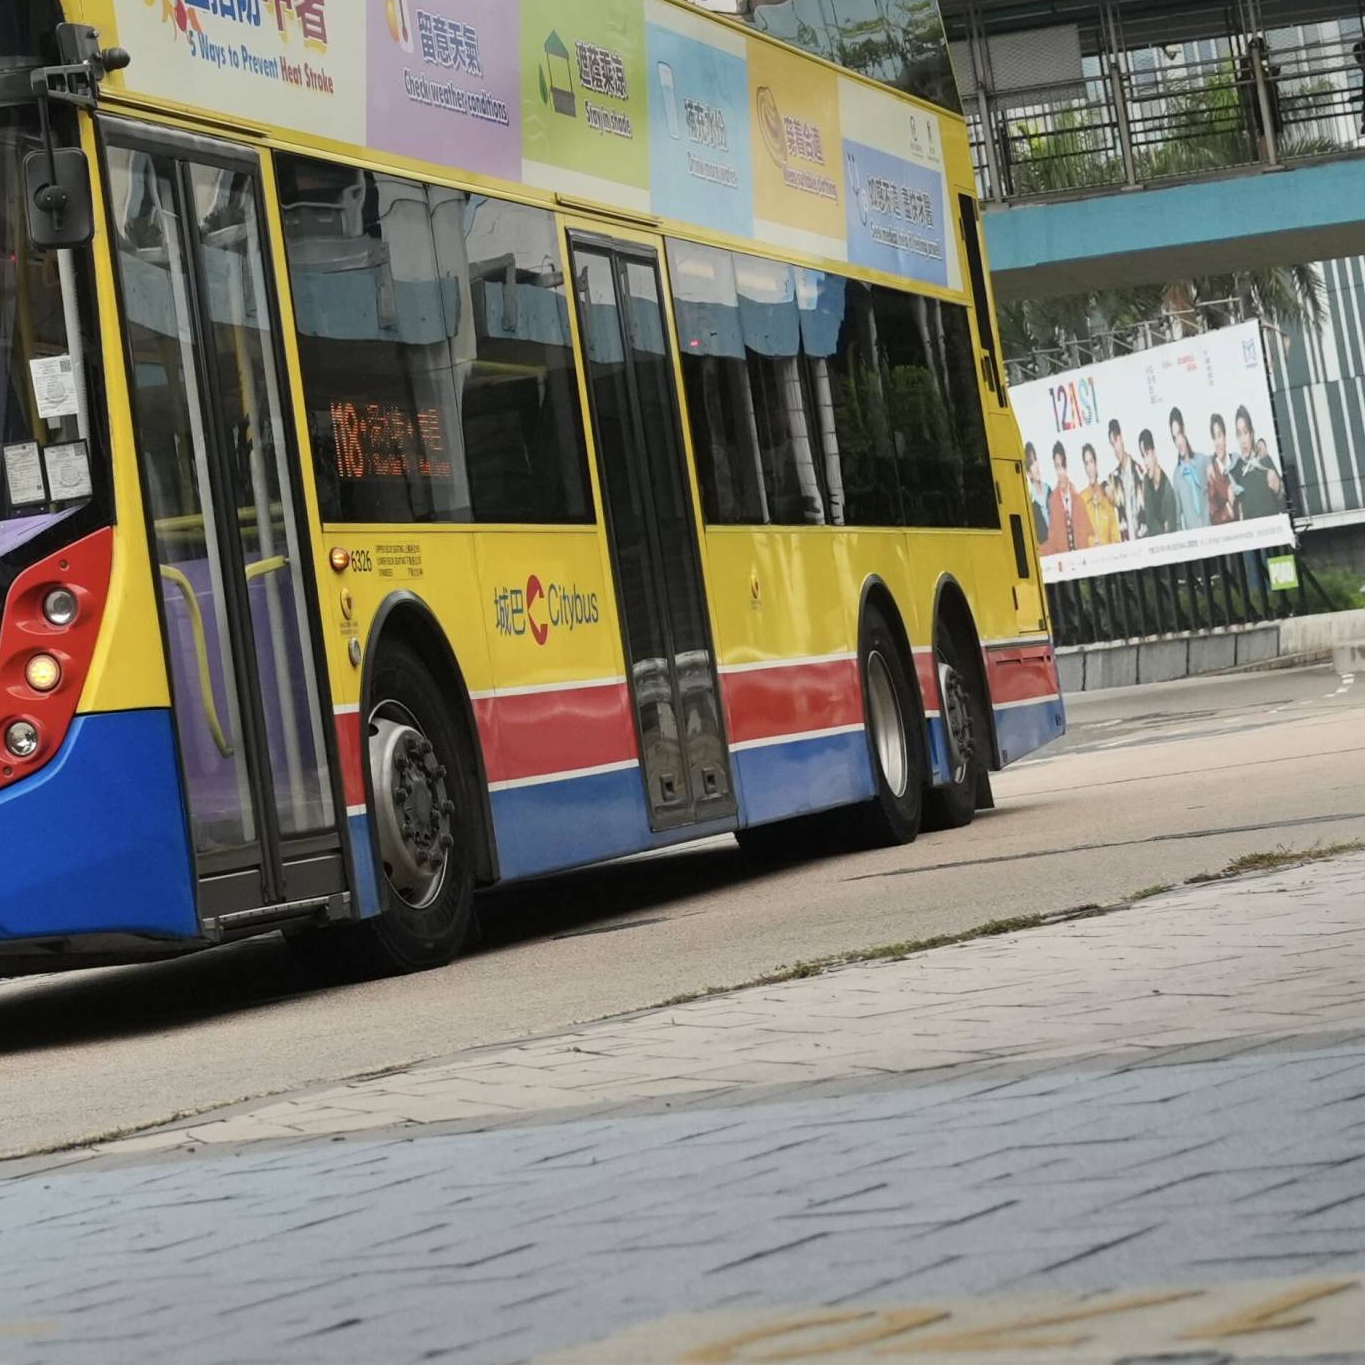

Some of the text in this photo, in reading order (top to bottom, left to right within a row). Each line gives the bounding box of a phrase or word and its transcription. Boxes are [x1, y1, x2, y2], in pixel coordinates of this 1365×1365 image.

[188, 30, 334, 94] 5 Ways to Prevent Heat Stroke
[416, 10, 482, 75] 留意天氣
[404, 68, 509, 122] Check weather conditions
[350, 550, 372, 573] 6326
[493, 586, 526, 636] 城巴
[547, 582, 600, 631] Citybus
